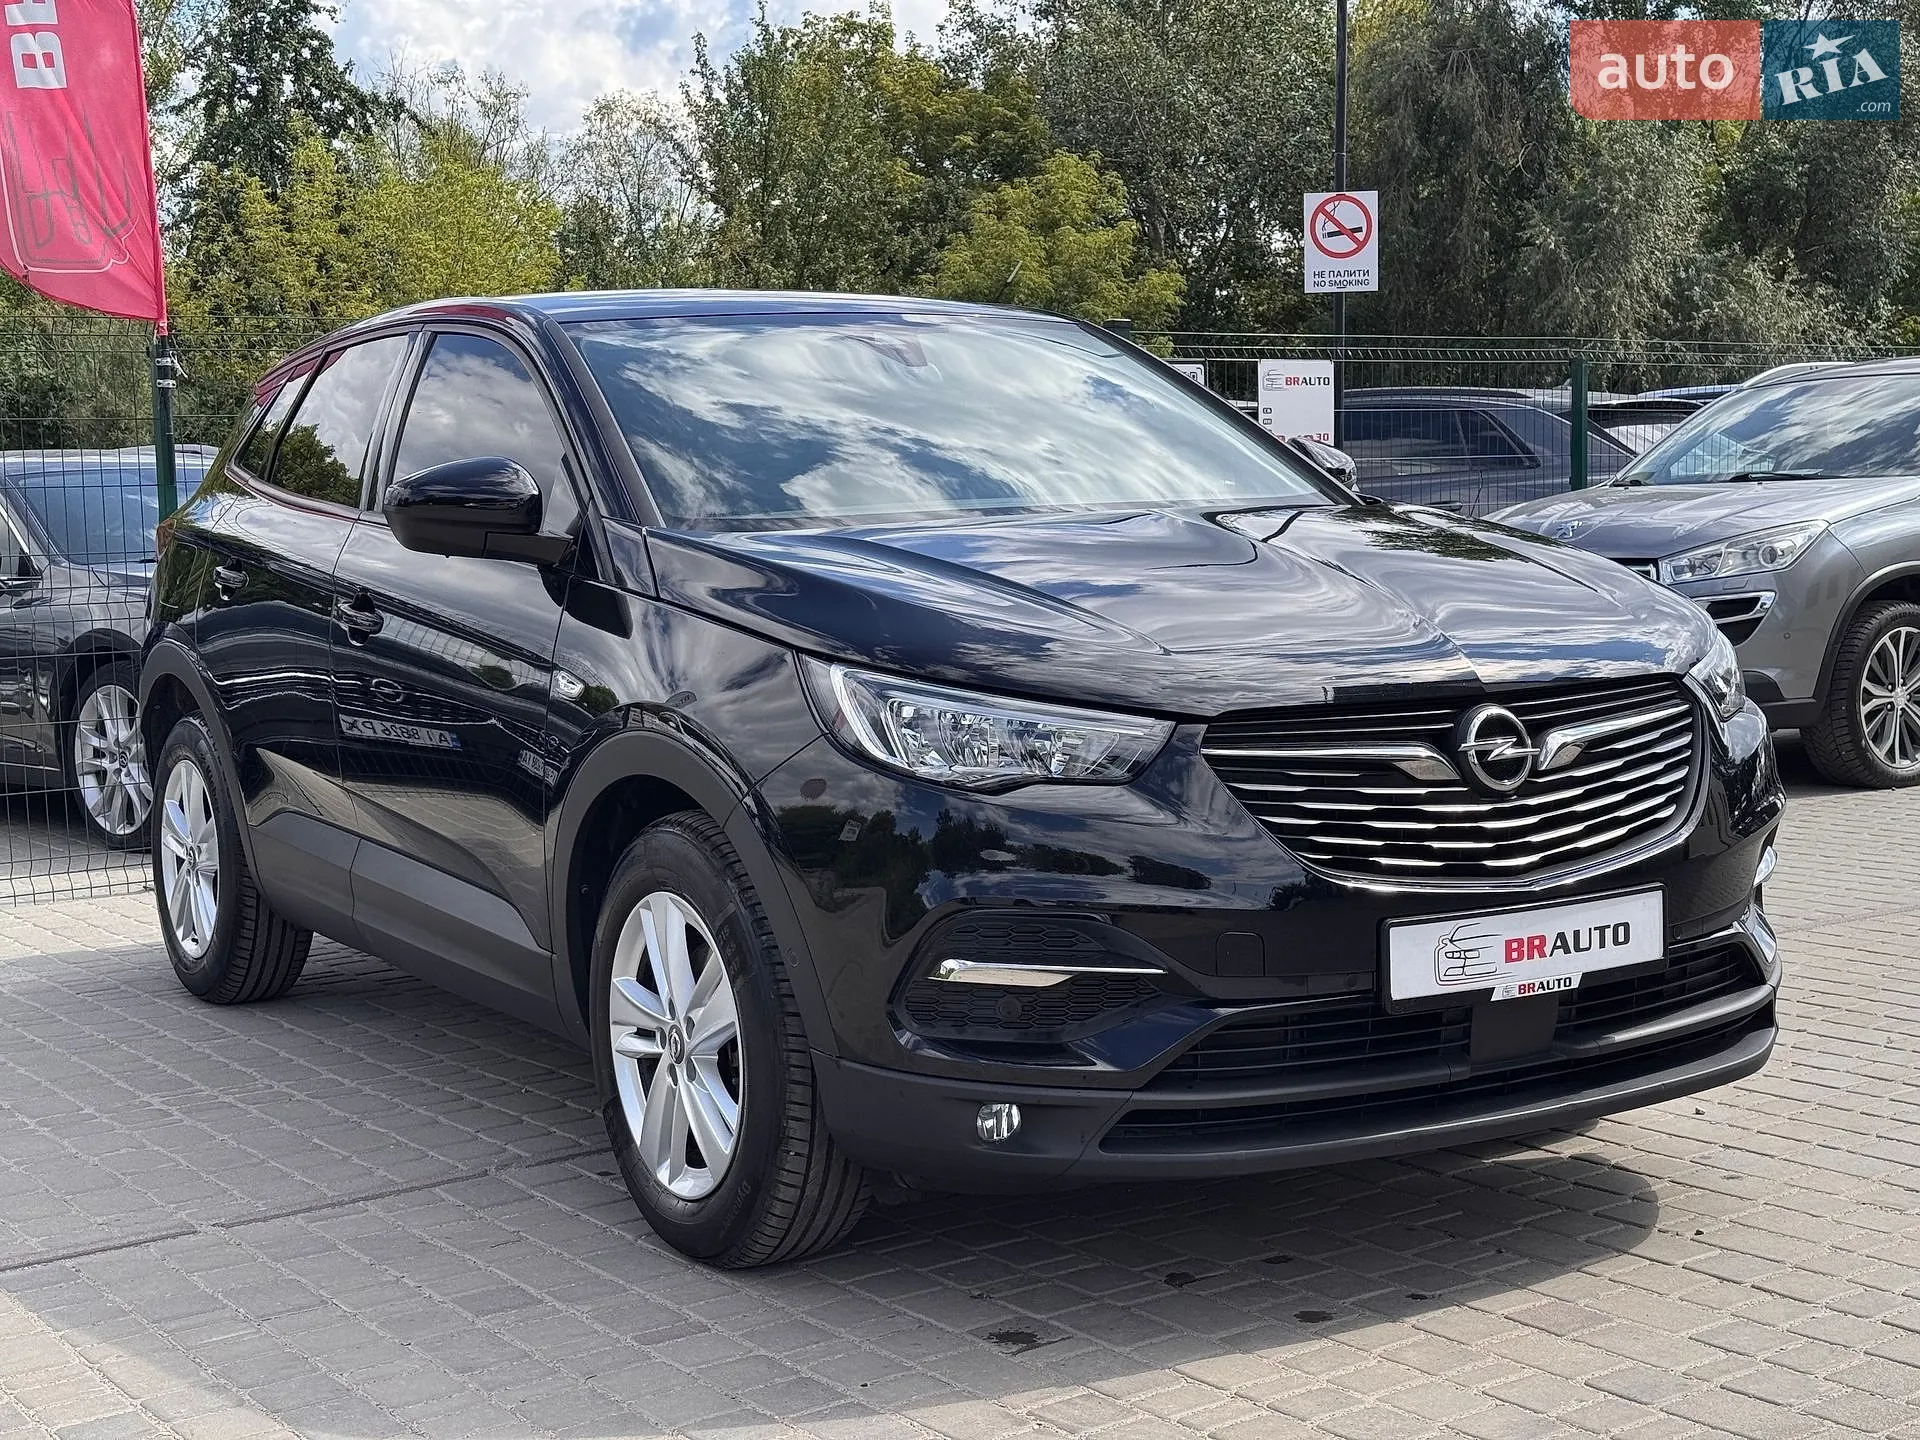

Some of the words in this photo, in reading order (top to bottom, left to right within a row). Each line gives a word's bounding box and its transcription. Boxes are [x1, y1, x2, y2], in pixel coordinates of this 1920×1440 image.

[1313, 270, 1326, 279] НЕ
[1328, 269, 1370, 279] ПАЛИТИ
[1313, 280, 1326, 288] NO
[1328, 278, 1370, 288] SMOKING
[1285, 376, 1330, 386] BRAUTO
[1504, 920, 1631, 964] BRAUTO
[1517, 976, 1572, 996] BRAUTO
